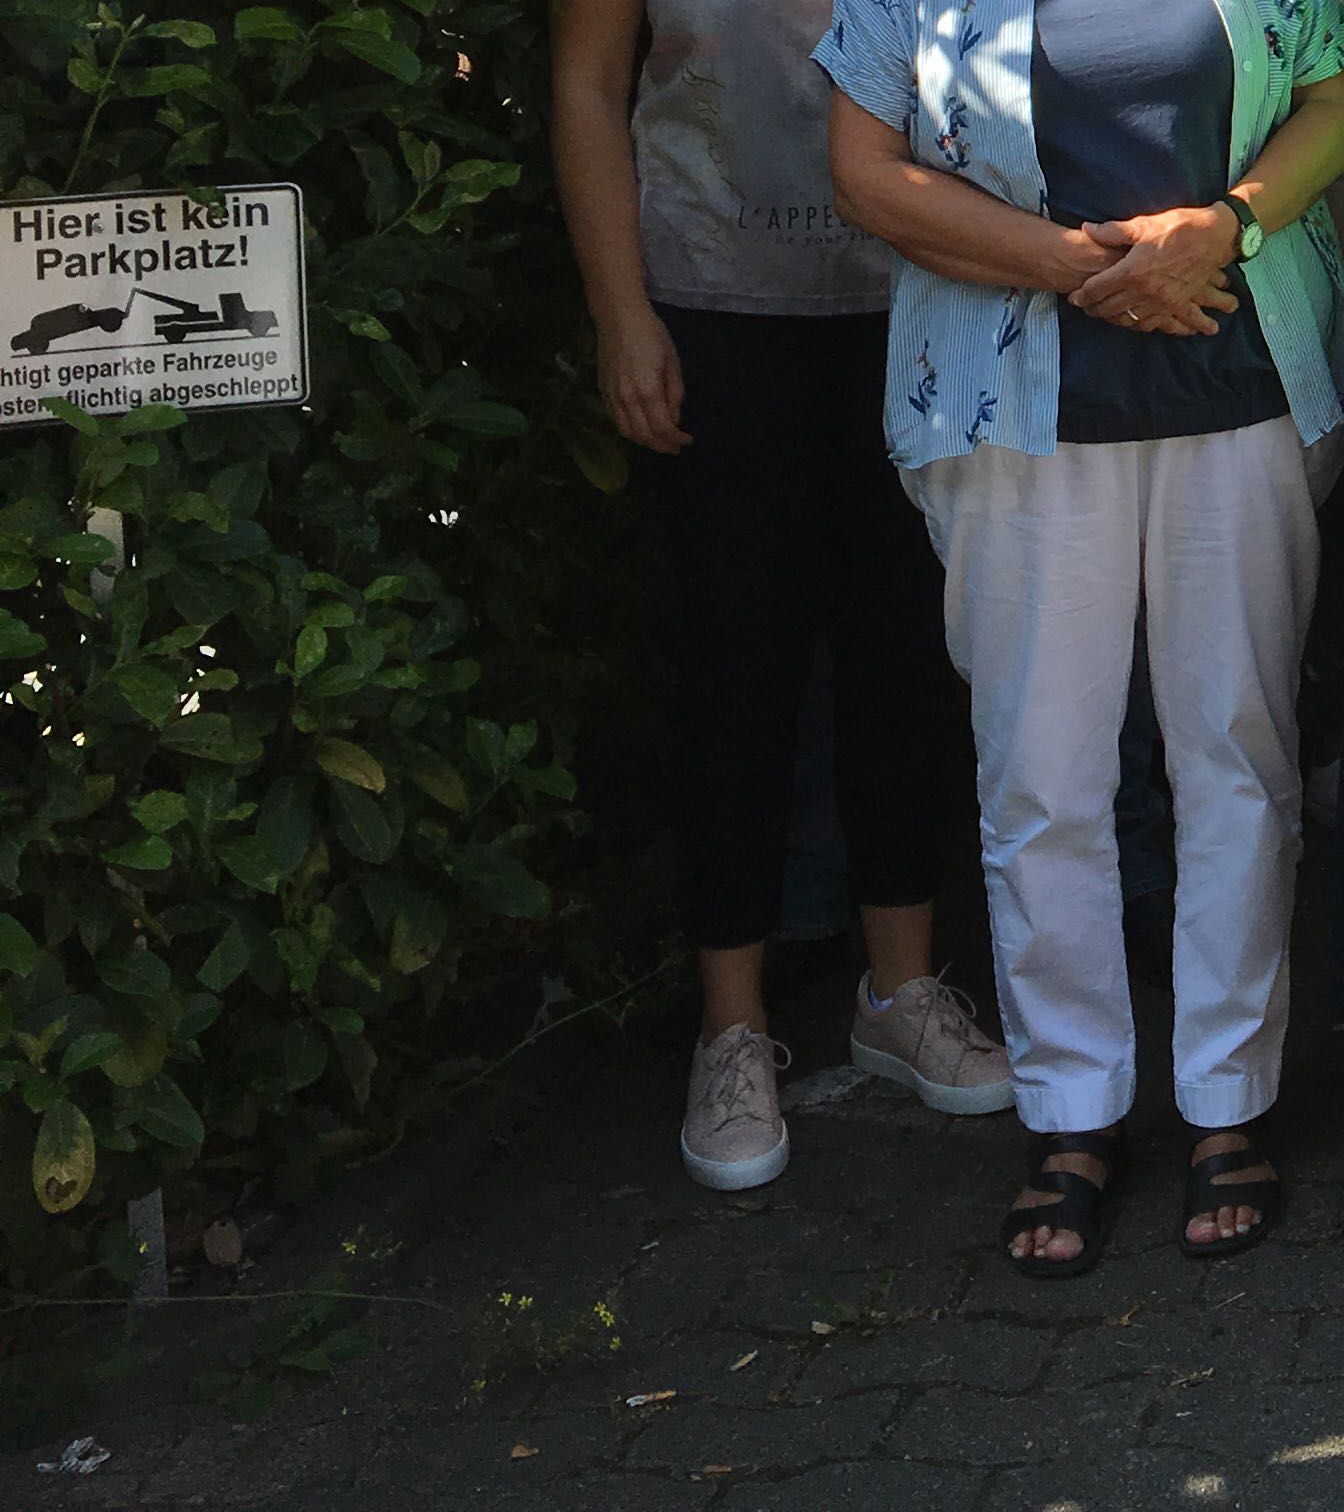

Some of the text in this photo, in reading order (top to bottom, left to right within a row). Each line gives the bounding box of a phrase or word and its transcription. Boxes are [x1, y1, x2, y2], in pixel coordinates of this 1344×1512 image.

[13, 196, 270, 243] Hier ist kein
[36, 235, 249, 282] Parkplatz!
[57, 356, 156, 387] geparkte
[163, 349, 279, 374] Fahrzeuge
[150, 374, 299, 404] abgeschleppt
